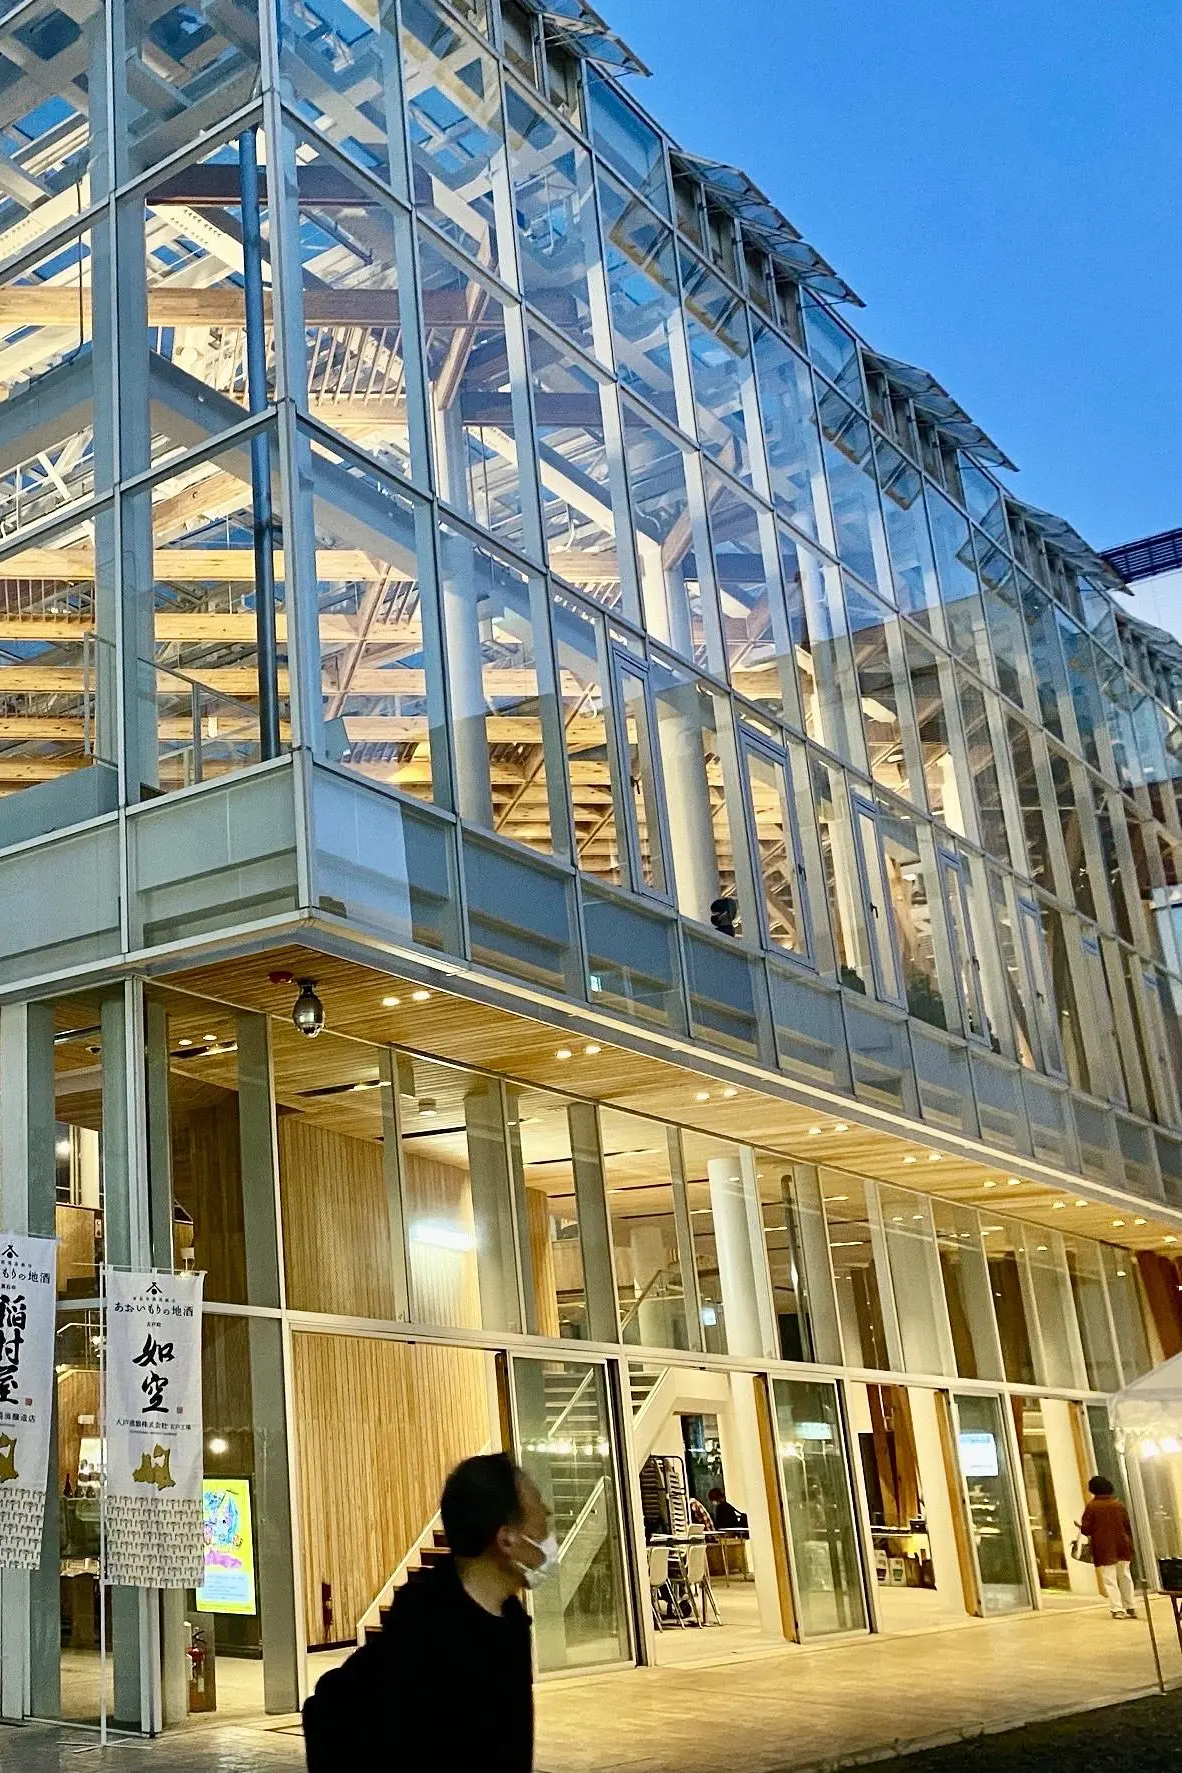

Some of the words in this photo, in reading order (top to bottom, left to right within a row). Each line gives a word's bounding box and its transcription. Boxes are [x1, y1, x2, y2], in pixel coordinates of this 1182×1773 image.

[115, 1302, 194, 1317] あおいもりの地酒
[132, 1333, 175, 1414] 如空
